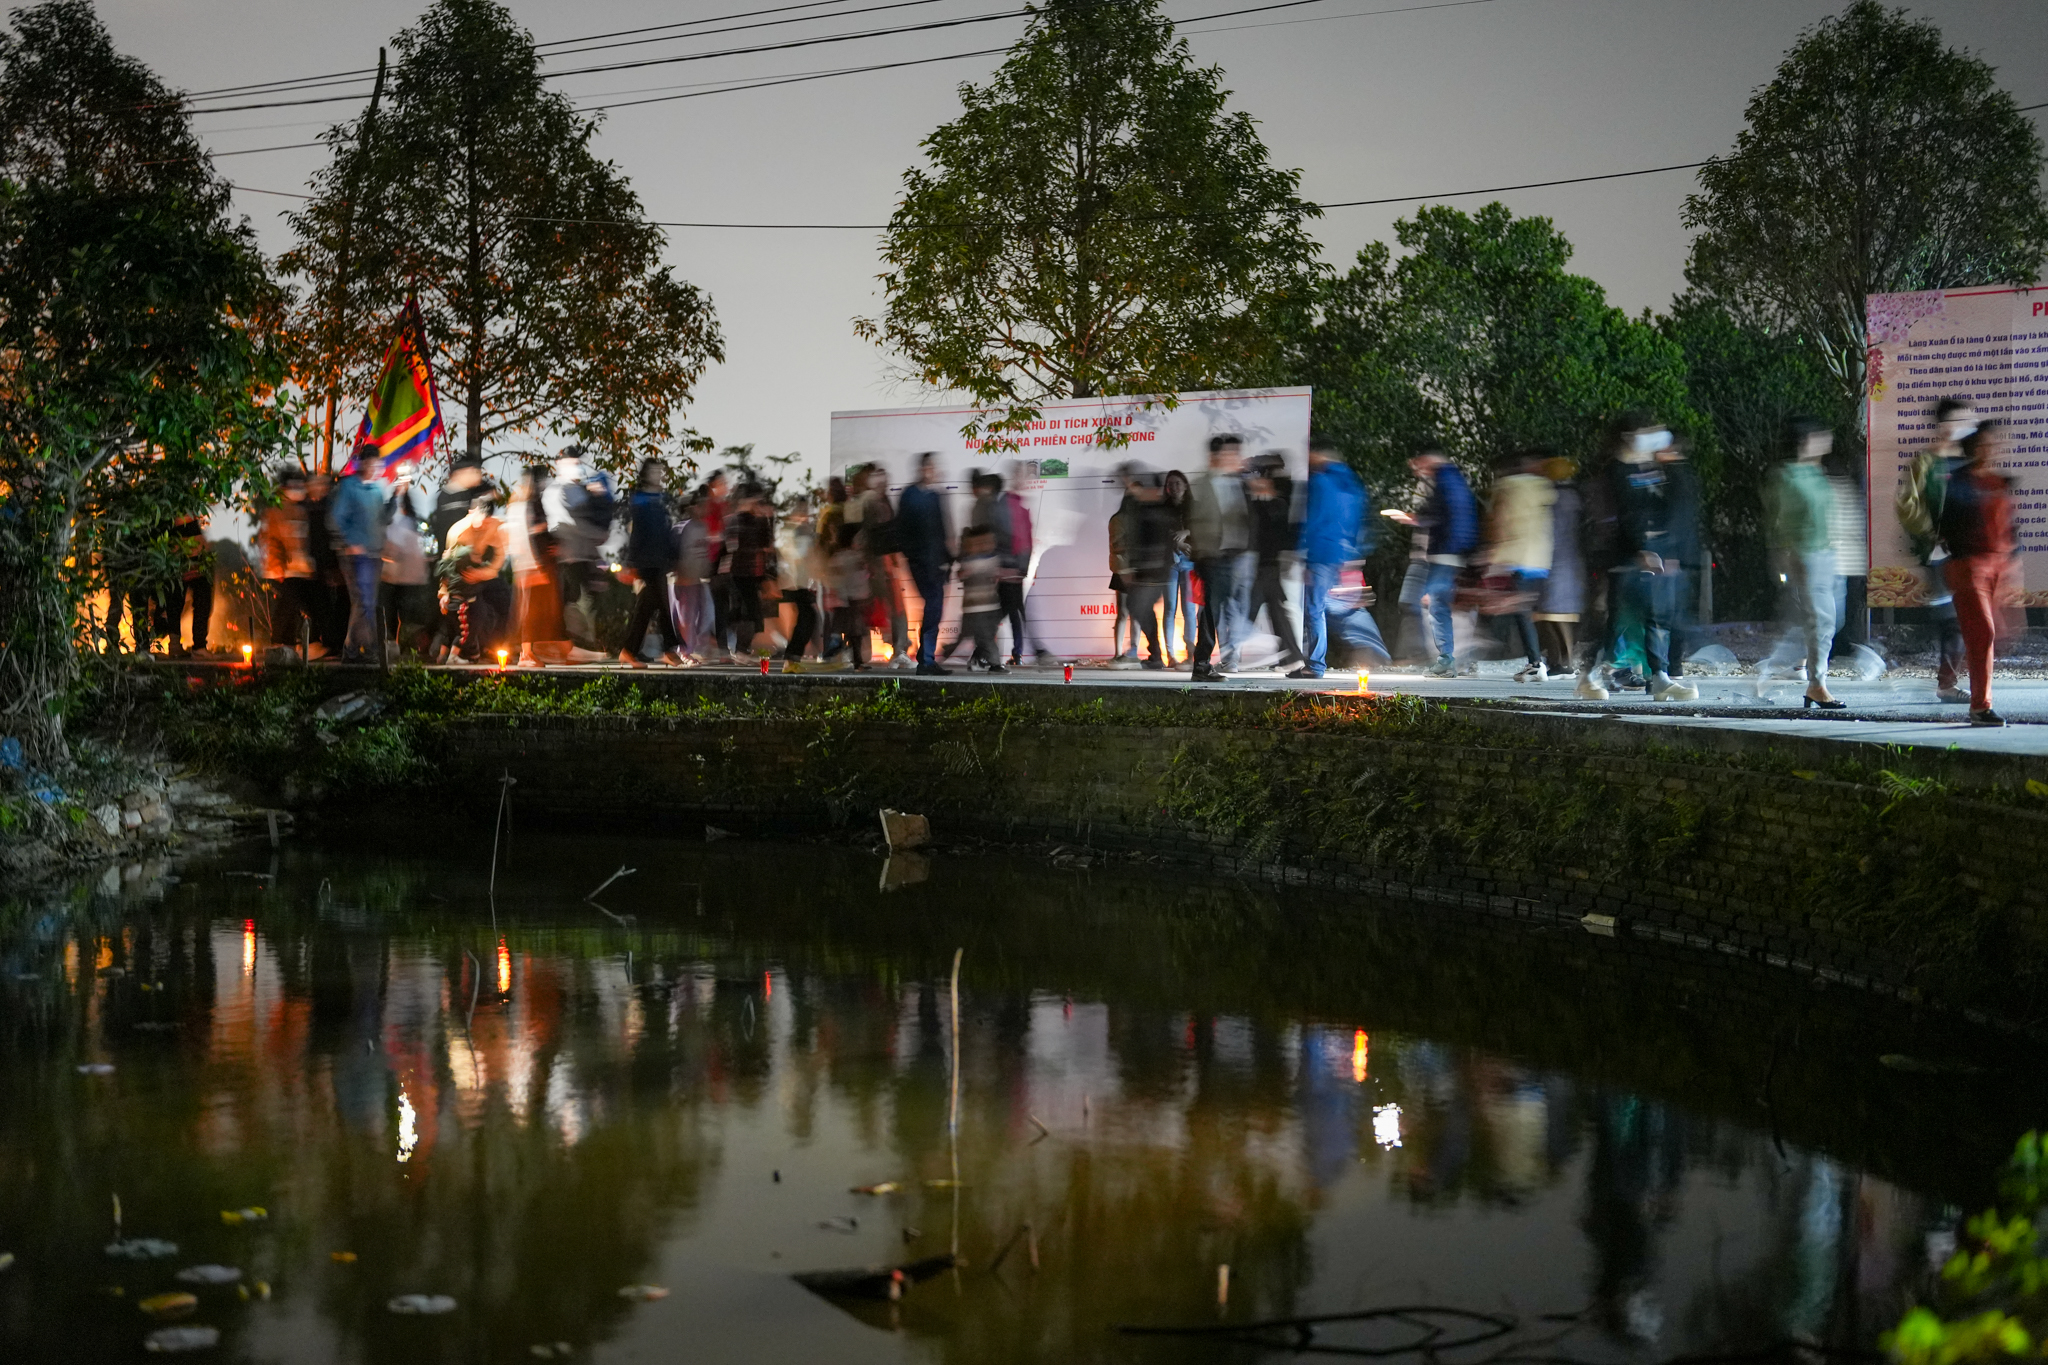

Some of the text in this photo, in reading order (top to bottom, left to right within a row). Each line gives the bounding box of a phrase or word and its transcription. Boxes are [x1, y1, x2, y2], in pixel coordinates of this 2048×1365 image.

[1909, 367, 1928, 375] Theo
[1944, 366, 1963, 374] gian
[1897, 382, 1910, 390] Địa
[1932, 380, 1947, 388] họp
[1971, 378, 1987, 386] khu
[1917, 394, 1940, 402] thành
[1991, 391, 2008, 399] đen
[2008, 390, 2024, 398] bay
[2004, 404, 2021, 412] cho
[1024, 420, 1046, 431] KHU
[1049, 419, 1061, 430] DI
[1064, 416, 1088, 429] TÍCH
[1091, 415, 1122, 427] XUÂN
[1897, 423, 1915, 431] Mua
[1016, 437, 1030, 447] RA
[1033, 433, 1067, 446] PHIÊN
[1070, 433, 1092, 446] CHỢ
[1908, 436, 1930, 445] phiên
[1898, 451, 1913, 459] Qua
[2014, 488, 2030, 497] chợ
[2030, 516, 2047, 524] các
[1080, 602, 1119, 615] KHU DÂ
